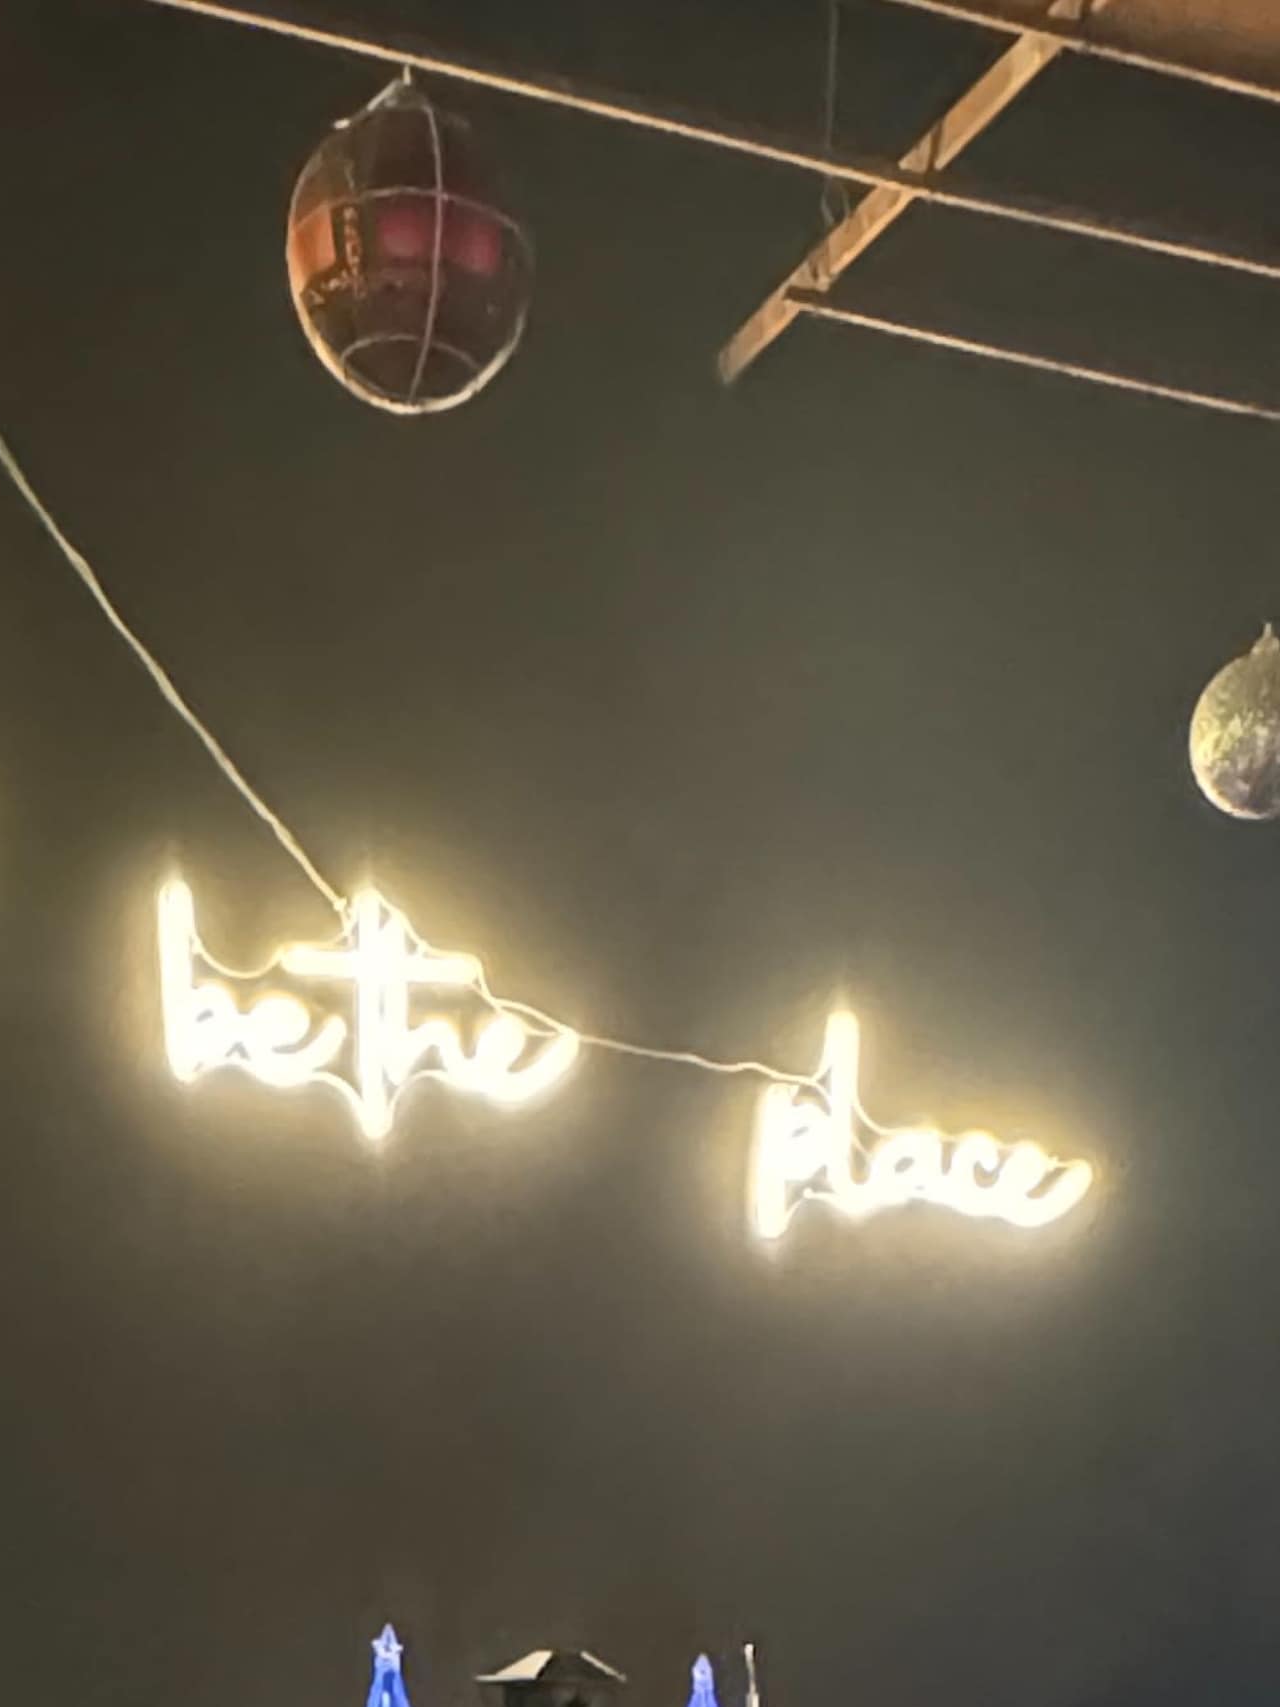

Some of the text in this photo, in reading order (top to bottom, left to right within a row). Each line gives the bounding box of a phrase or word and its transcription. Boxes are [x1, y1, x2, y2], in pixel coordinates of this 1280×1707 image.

[156, 878, 350, 1090] be
[278, 886, 582, 1144] the
[750, 1008, 1095, 1242] place
